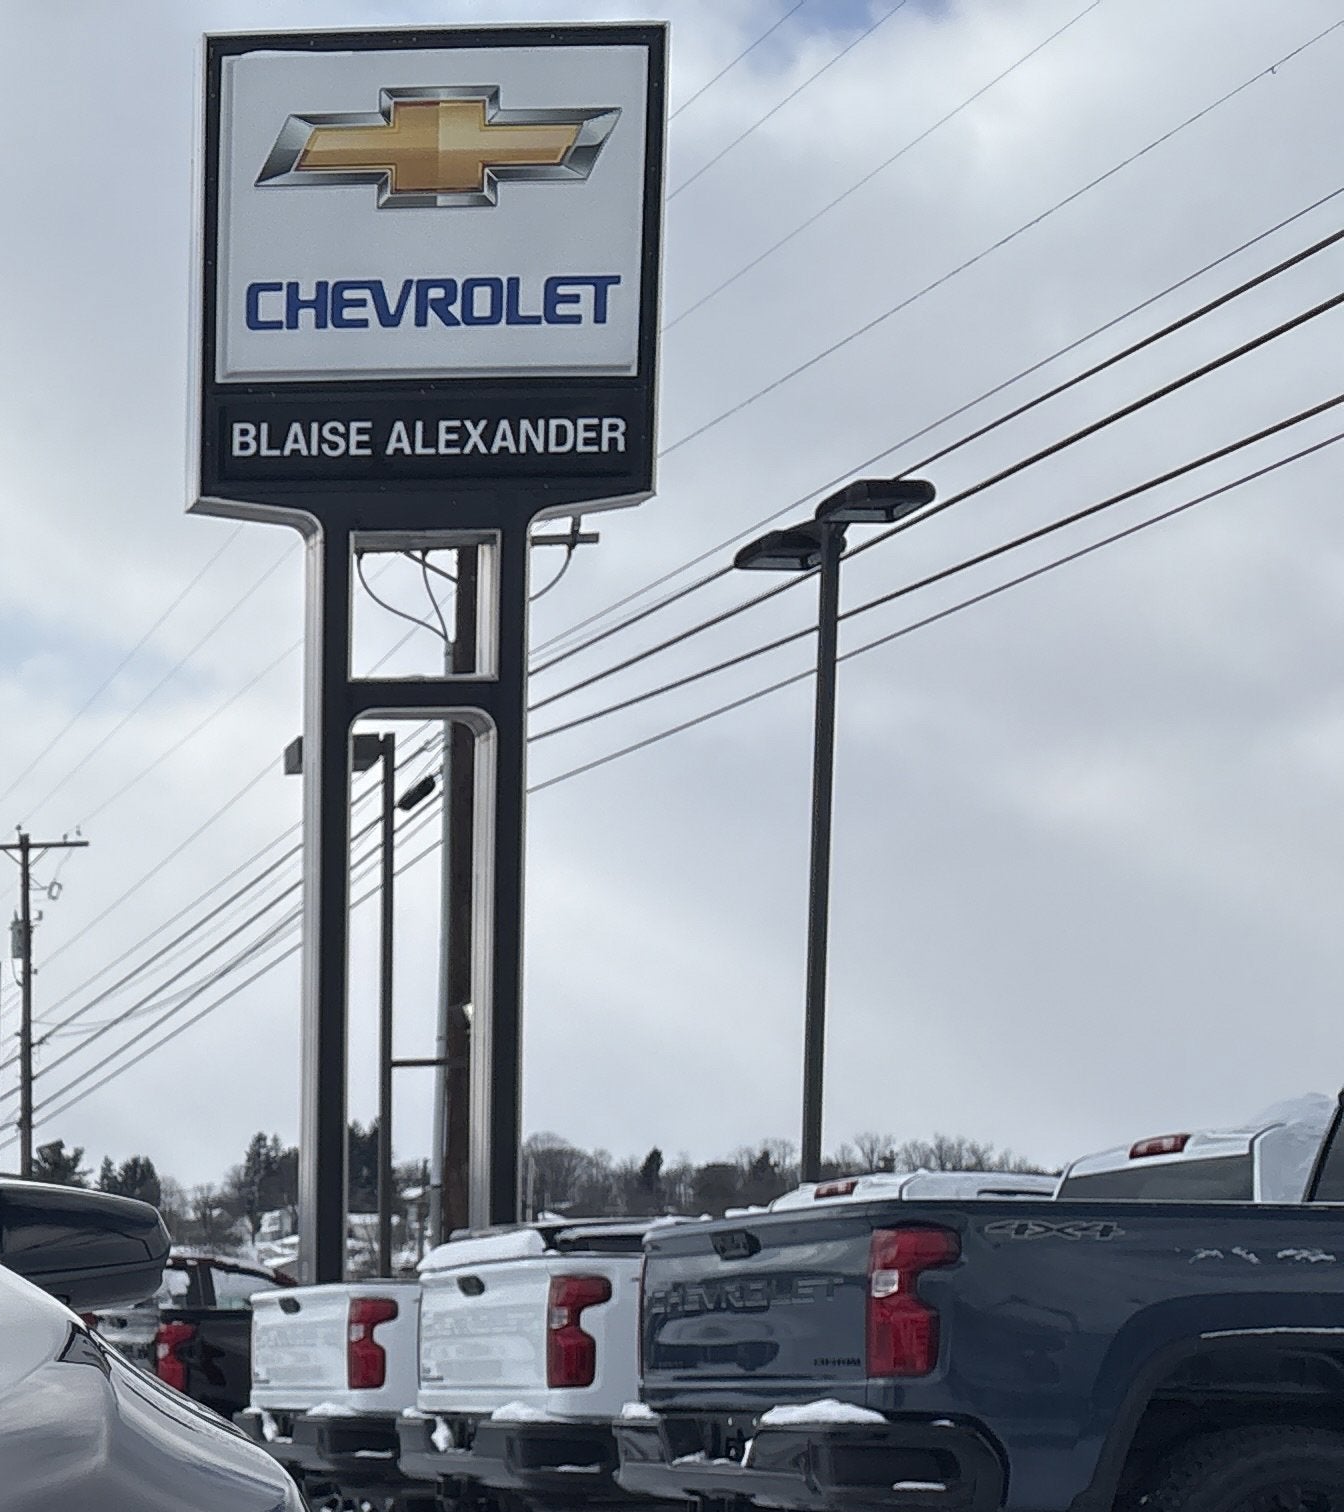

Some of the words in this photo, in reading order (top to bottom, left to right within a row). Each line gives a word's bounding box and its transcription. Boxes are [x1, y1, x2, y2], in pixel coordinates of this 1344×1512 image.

[245, 275, 621, 331] CHEVROLET
[231, 421, 373, 458] BLAISE
[385, 417, 627, 456] ALEXANDER
